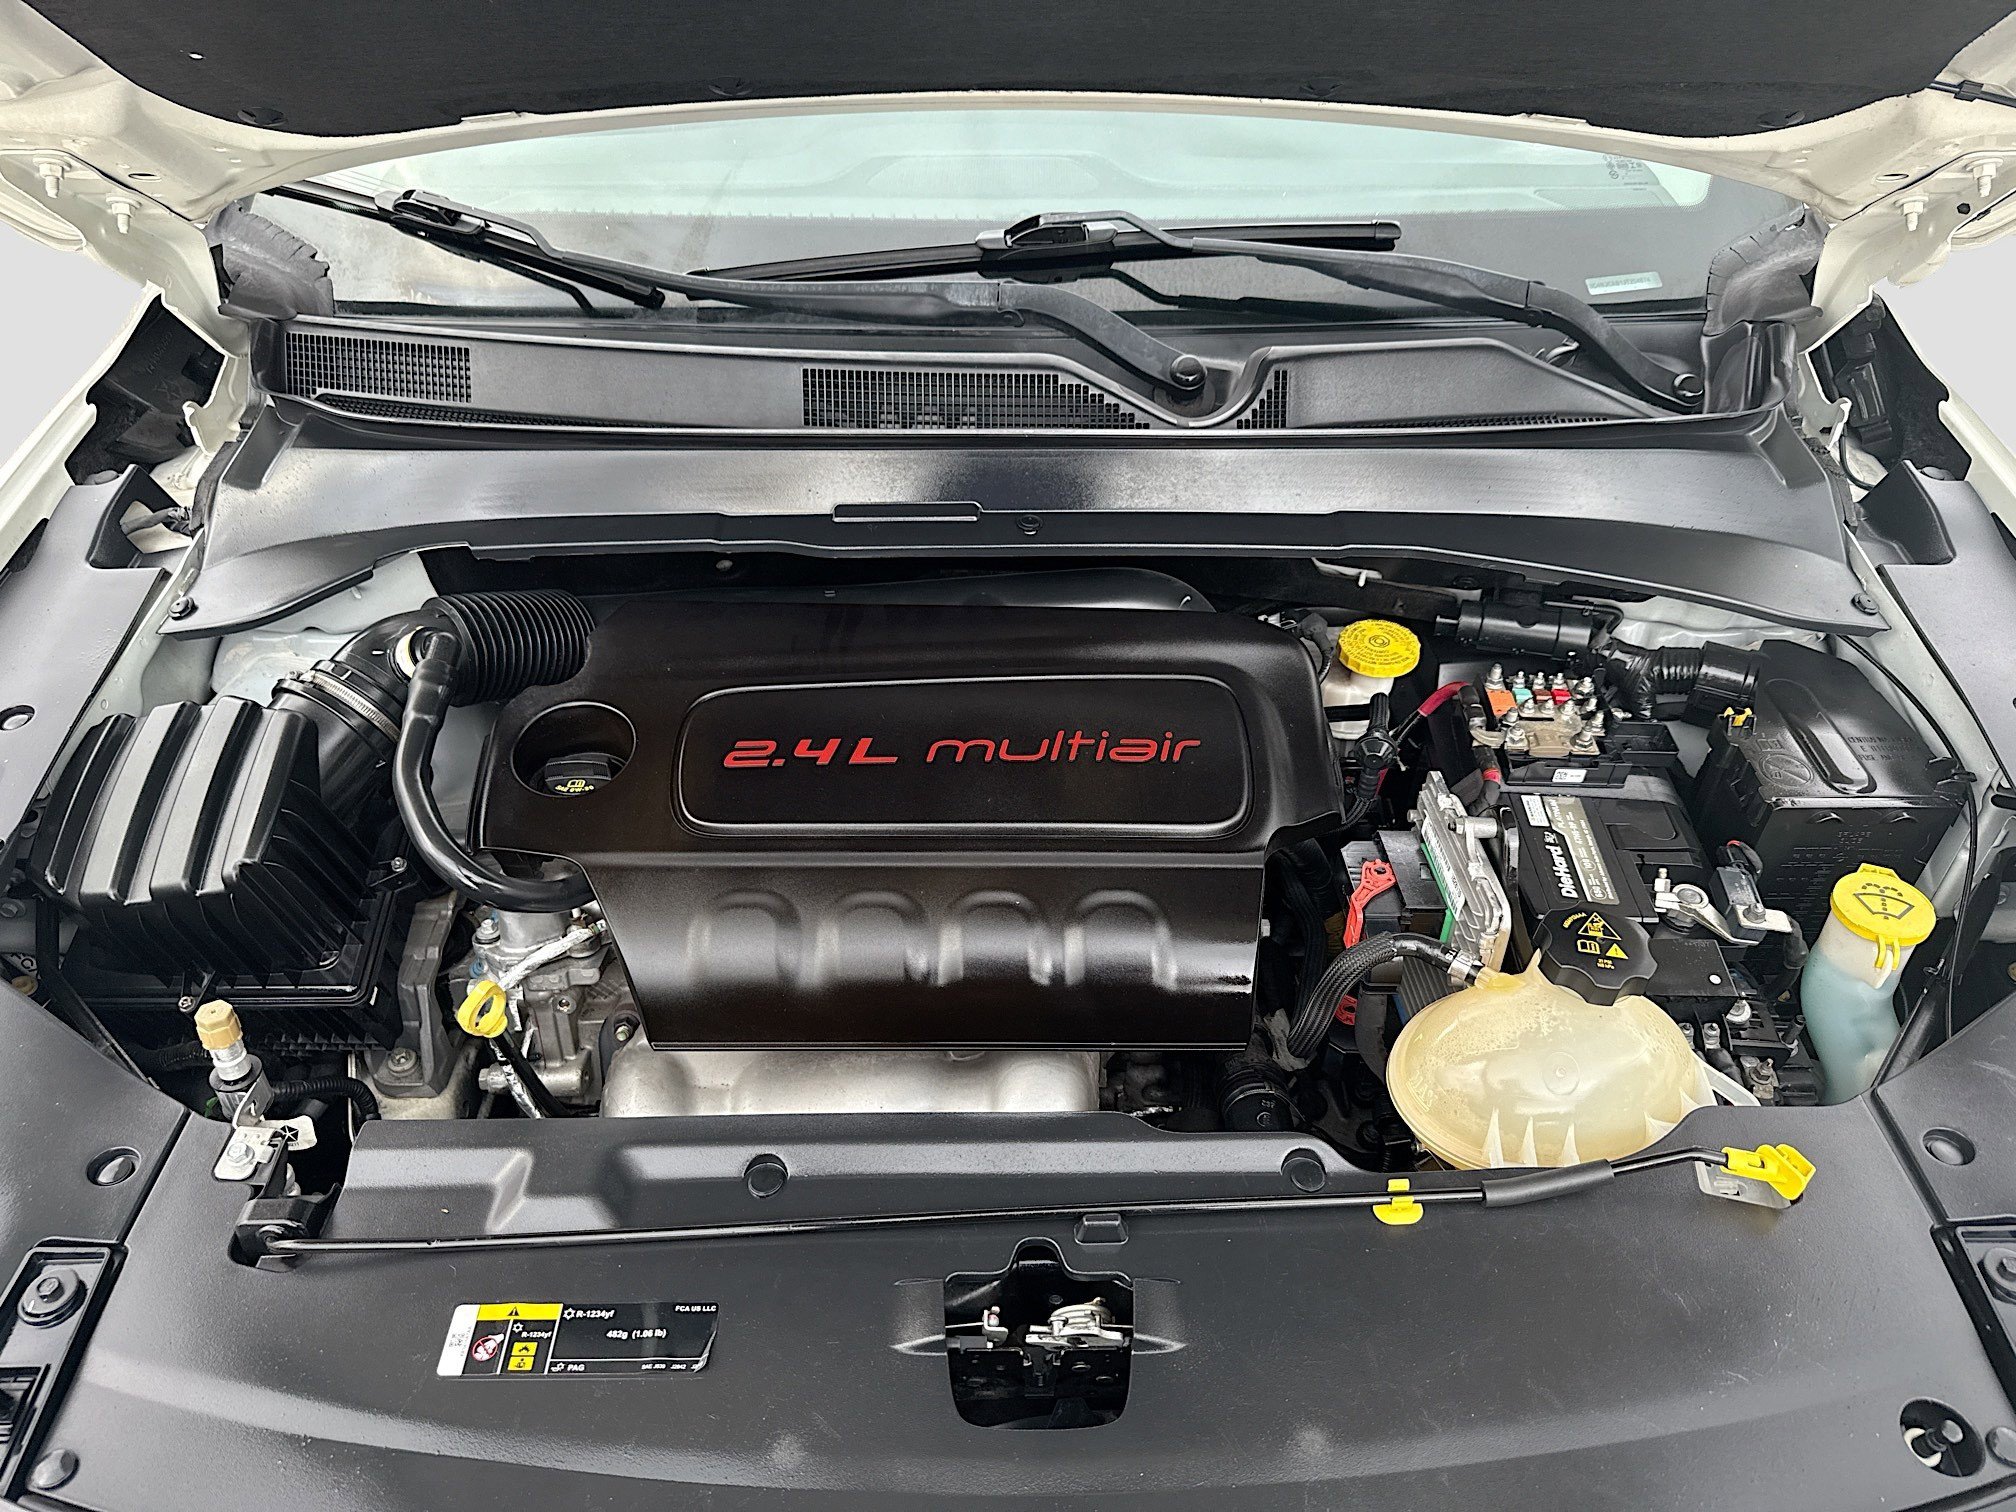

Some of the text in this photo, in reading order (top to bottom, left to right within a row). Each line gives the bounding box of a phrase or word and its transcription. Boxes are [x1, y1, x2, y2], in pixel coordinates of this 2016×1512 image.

[926, 730, 1201, 763] multiair
[1545, 844, 1579, 899] DieHard
[575, 1309, 615, 1320] R-1234yf
[521, 1331, 552, 1339] R-1234yf
[606, 1329, 628, 1340] 482g
[567, 1363, 585, 1372] PAG
